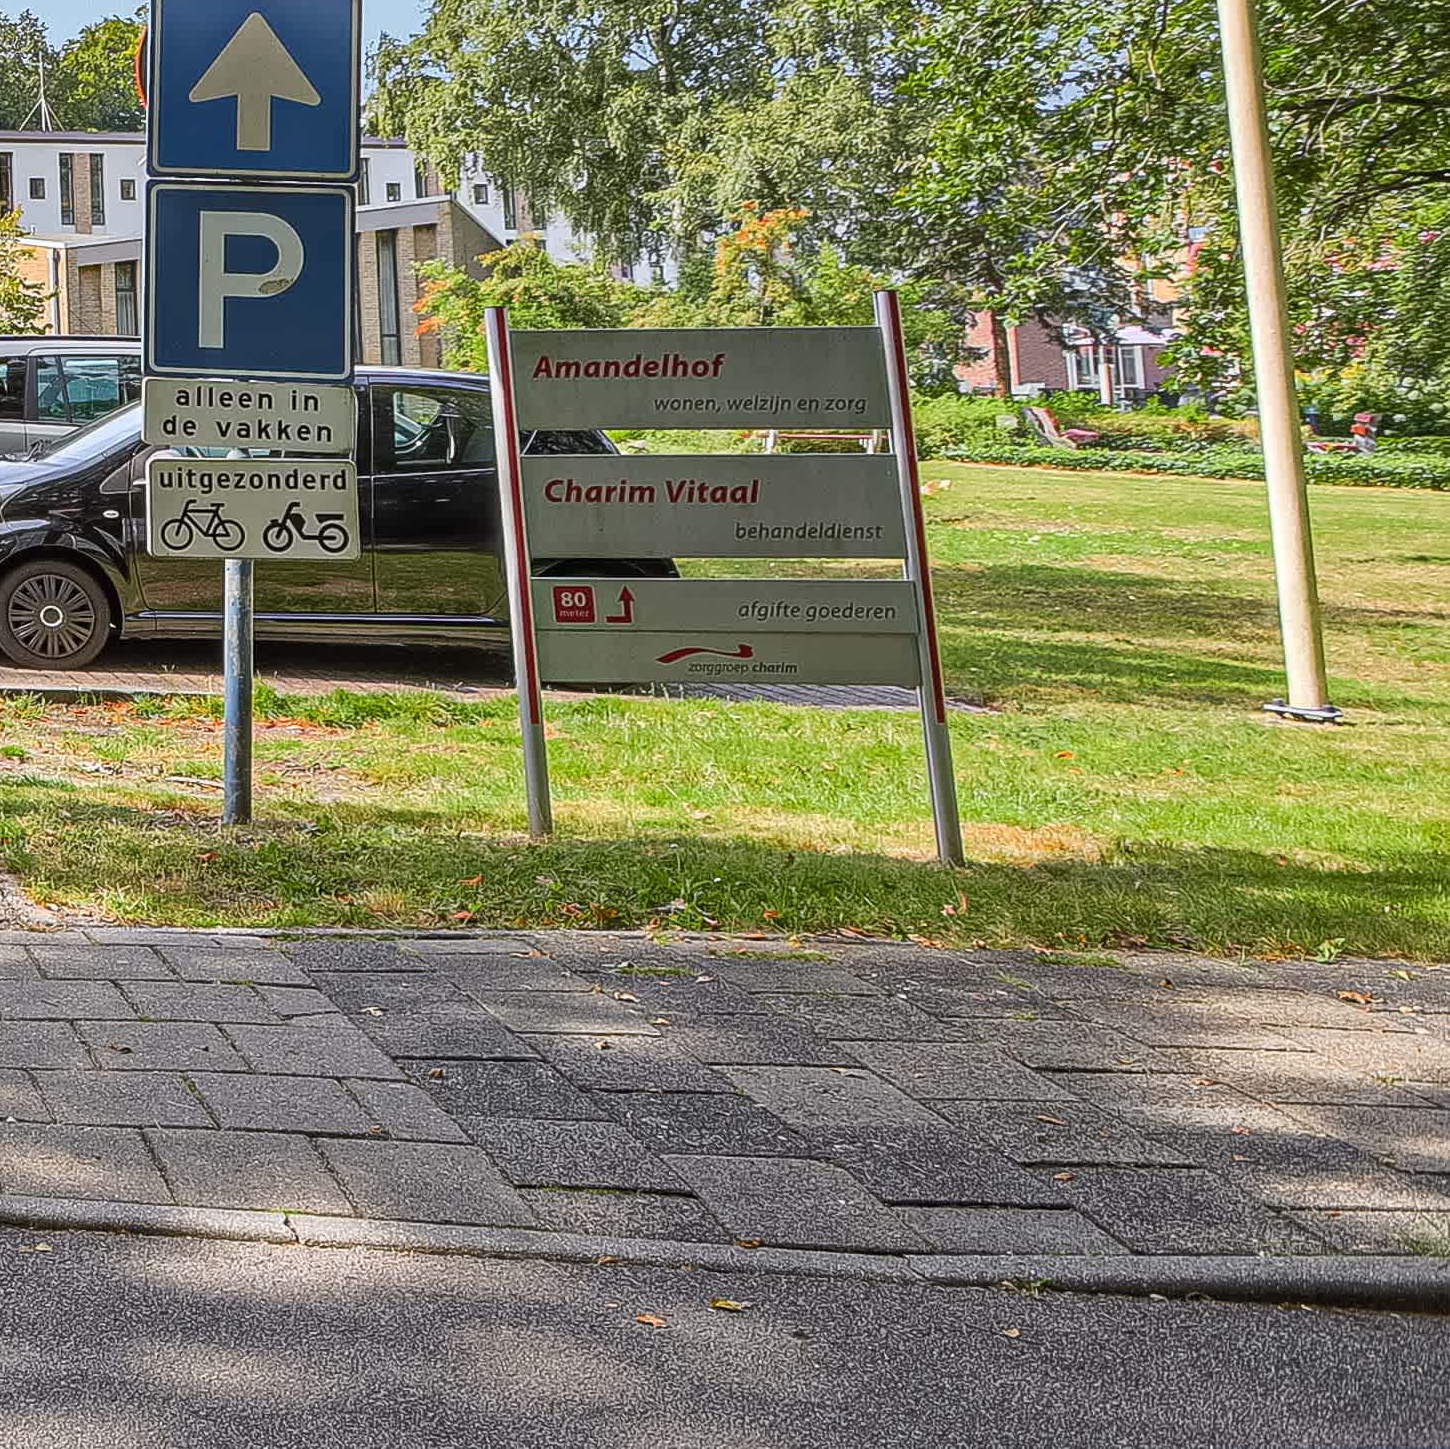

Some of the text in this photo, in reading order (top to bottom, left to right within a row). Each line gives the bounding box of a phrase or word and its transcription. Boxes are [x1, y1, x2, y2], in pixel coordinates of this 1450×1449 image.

[198, 210, 305, 349] P
[533, 353, 726, 379] Amandelhof
[176, 386, 319, 412] alleen in
[653, 395, 867, 415] wonen, welzijn en zorg
[162, 414, 333, 443] de vakken
[159, 467, 347, 494] uitgezonderd
[544, 479, 761, 504] Charim Vitaal
[734, 522, 883, 541] behandeldienst
[560, 591, 587, 607] 80
[559, 610, 590, 618] meter
[738, 601, 897, 623] afgifte goederen
[688, 661, 798, 676] zorggroep charim
